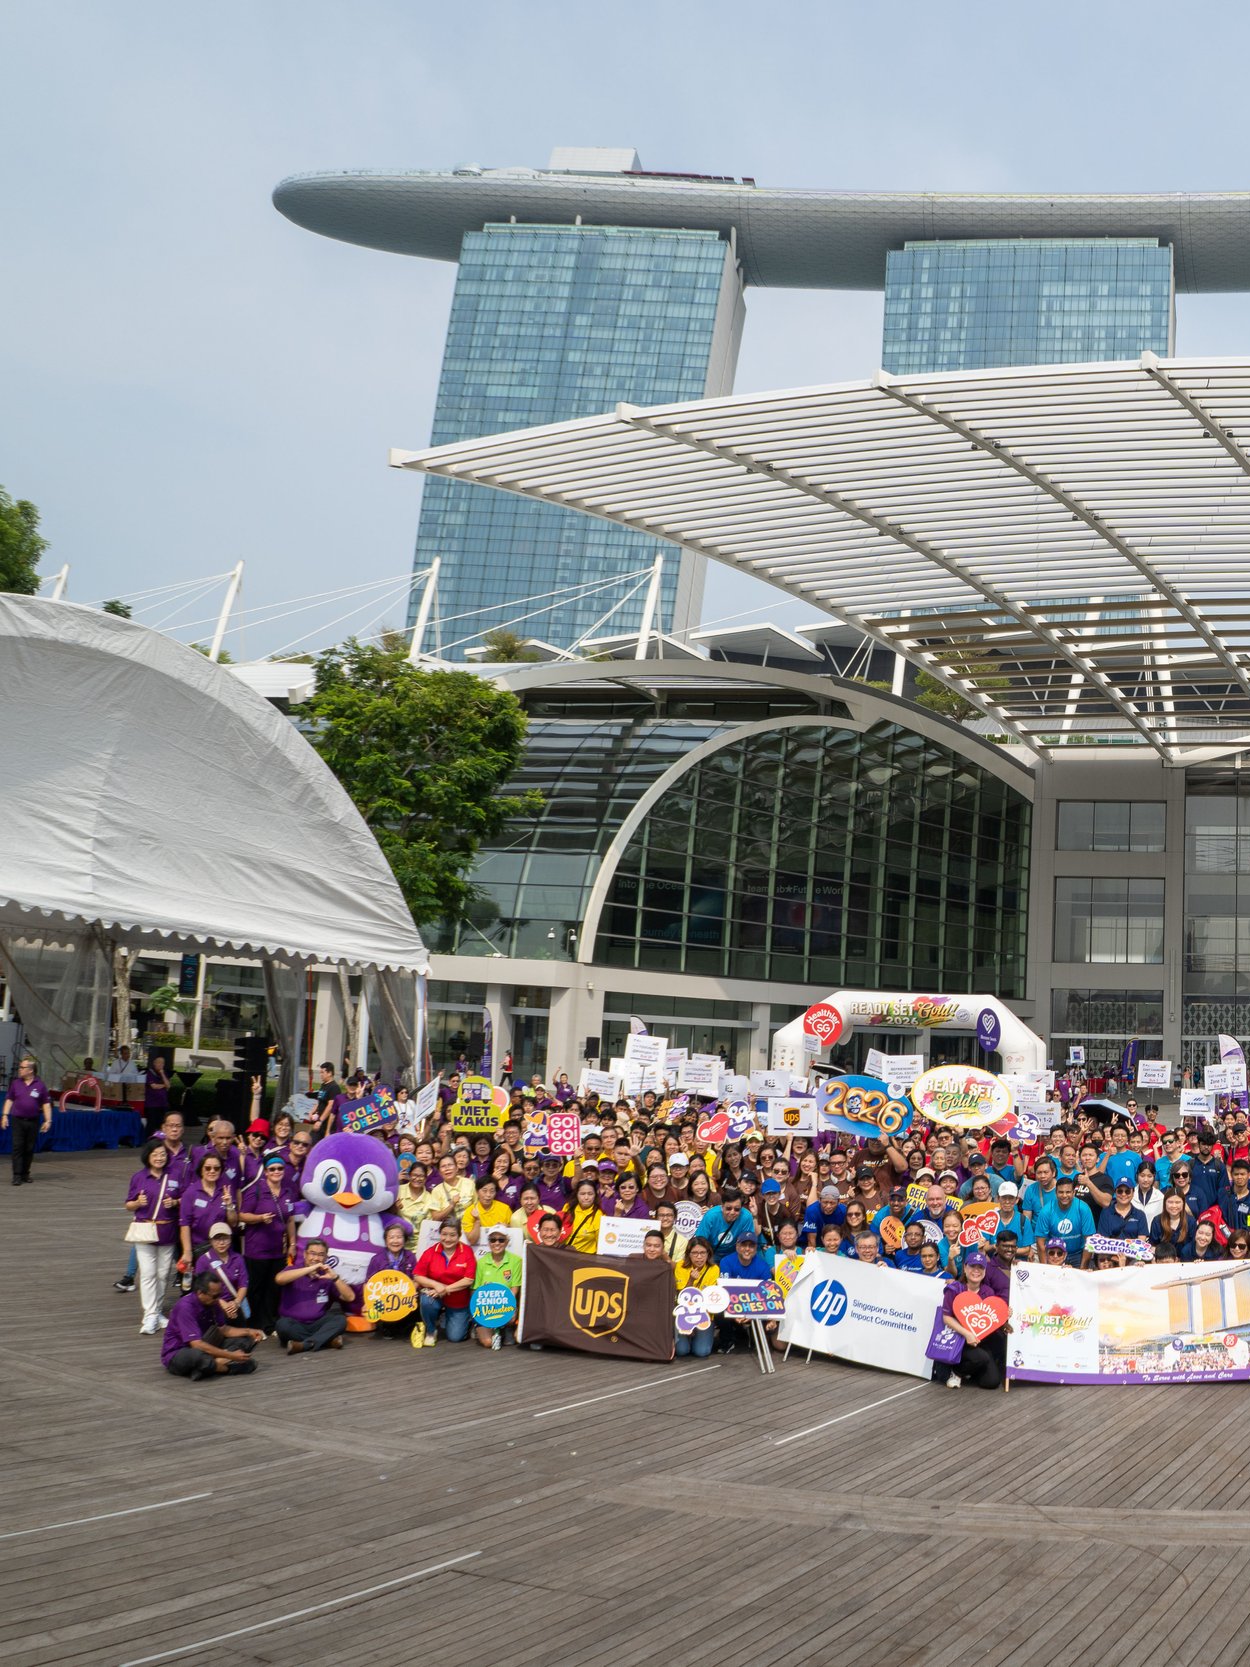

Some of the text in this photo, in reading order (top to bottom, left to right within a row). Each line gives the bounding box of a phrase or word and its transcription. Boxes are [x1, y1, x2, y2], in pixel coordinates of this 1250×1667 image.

[851, 1001, 960, 1018] READY SET Gold!
[806, 1008, 840, 1025] Healthier
[886, 1017, 919, 1025] 2026
[816, 1023, 830, 1033] SG
[926, 1078, 994, 1099] READY SET
[823, 1081, 908, 1133] 2026
[937, 1093, 979, 1111] Gold!
[342, 1102, 378, 1124] SOCIAL
[460, 1106, 491, 1116] MET
[454, 1117, 499, 1126] KAKIS
[550, 1117, 578, 1128] GO!
[784, 1112, 800, 1126] ups
[550, 1129, 578, 1140] GO!
[550, 1141, 578, 1152] GO!
[674, 1217, 700, 1229] HOPE
[1060, 1221, 1071, 1233] hp
[1089, 1238, 1130, 1248] SOCIAL
[1094, 1245, 1137, 1255] COHESION
[367, 1281, 411, 1300] Lovely
[478, 1290, 506, 1298] EVERY
[476, 1296, 509, 1305] SENIOR
[729, 1292, 765, 1303] OCIAL
[812, 1279, 847, 1327] hp
[473, 1304, 515, 1318] A Volunteer
[575, 1287, 623, 1327] ups
[728, 1300, 784, 1314] COHESION
[852, 1299, 914, 1320] Singapore Social
[960, 1302, 999, 1323] Healthier
[850, 1311, 917, 1333] Impact Committee
[970, 1317, 987, 1329] SG
[1016, 1314, 1094, 1328] READY SET Gold!
[1039, 1325, 1065, 1335] 2026
[1186, 1373, 1202, 1383] Love
[1218, 1371, 1233, 1379] Care
